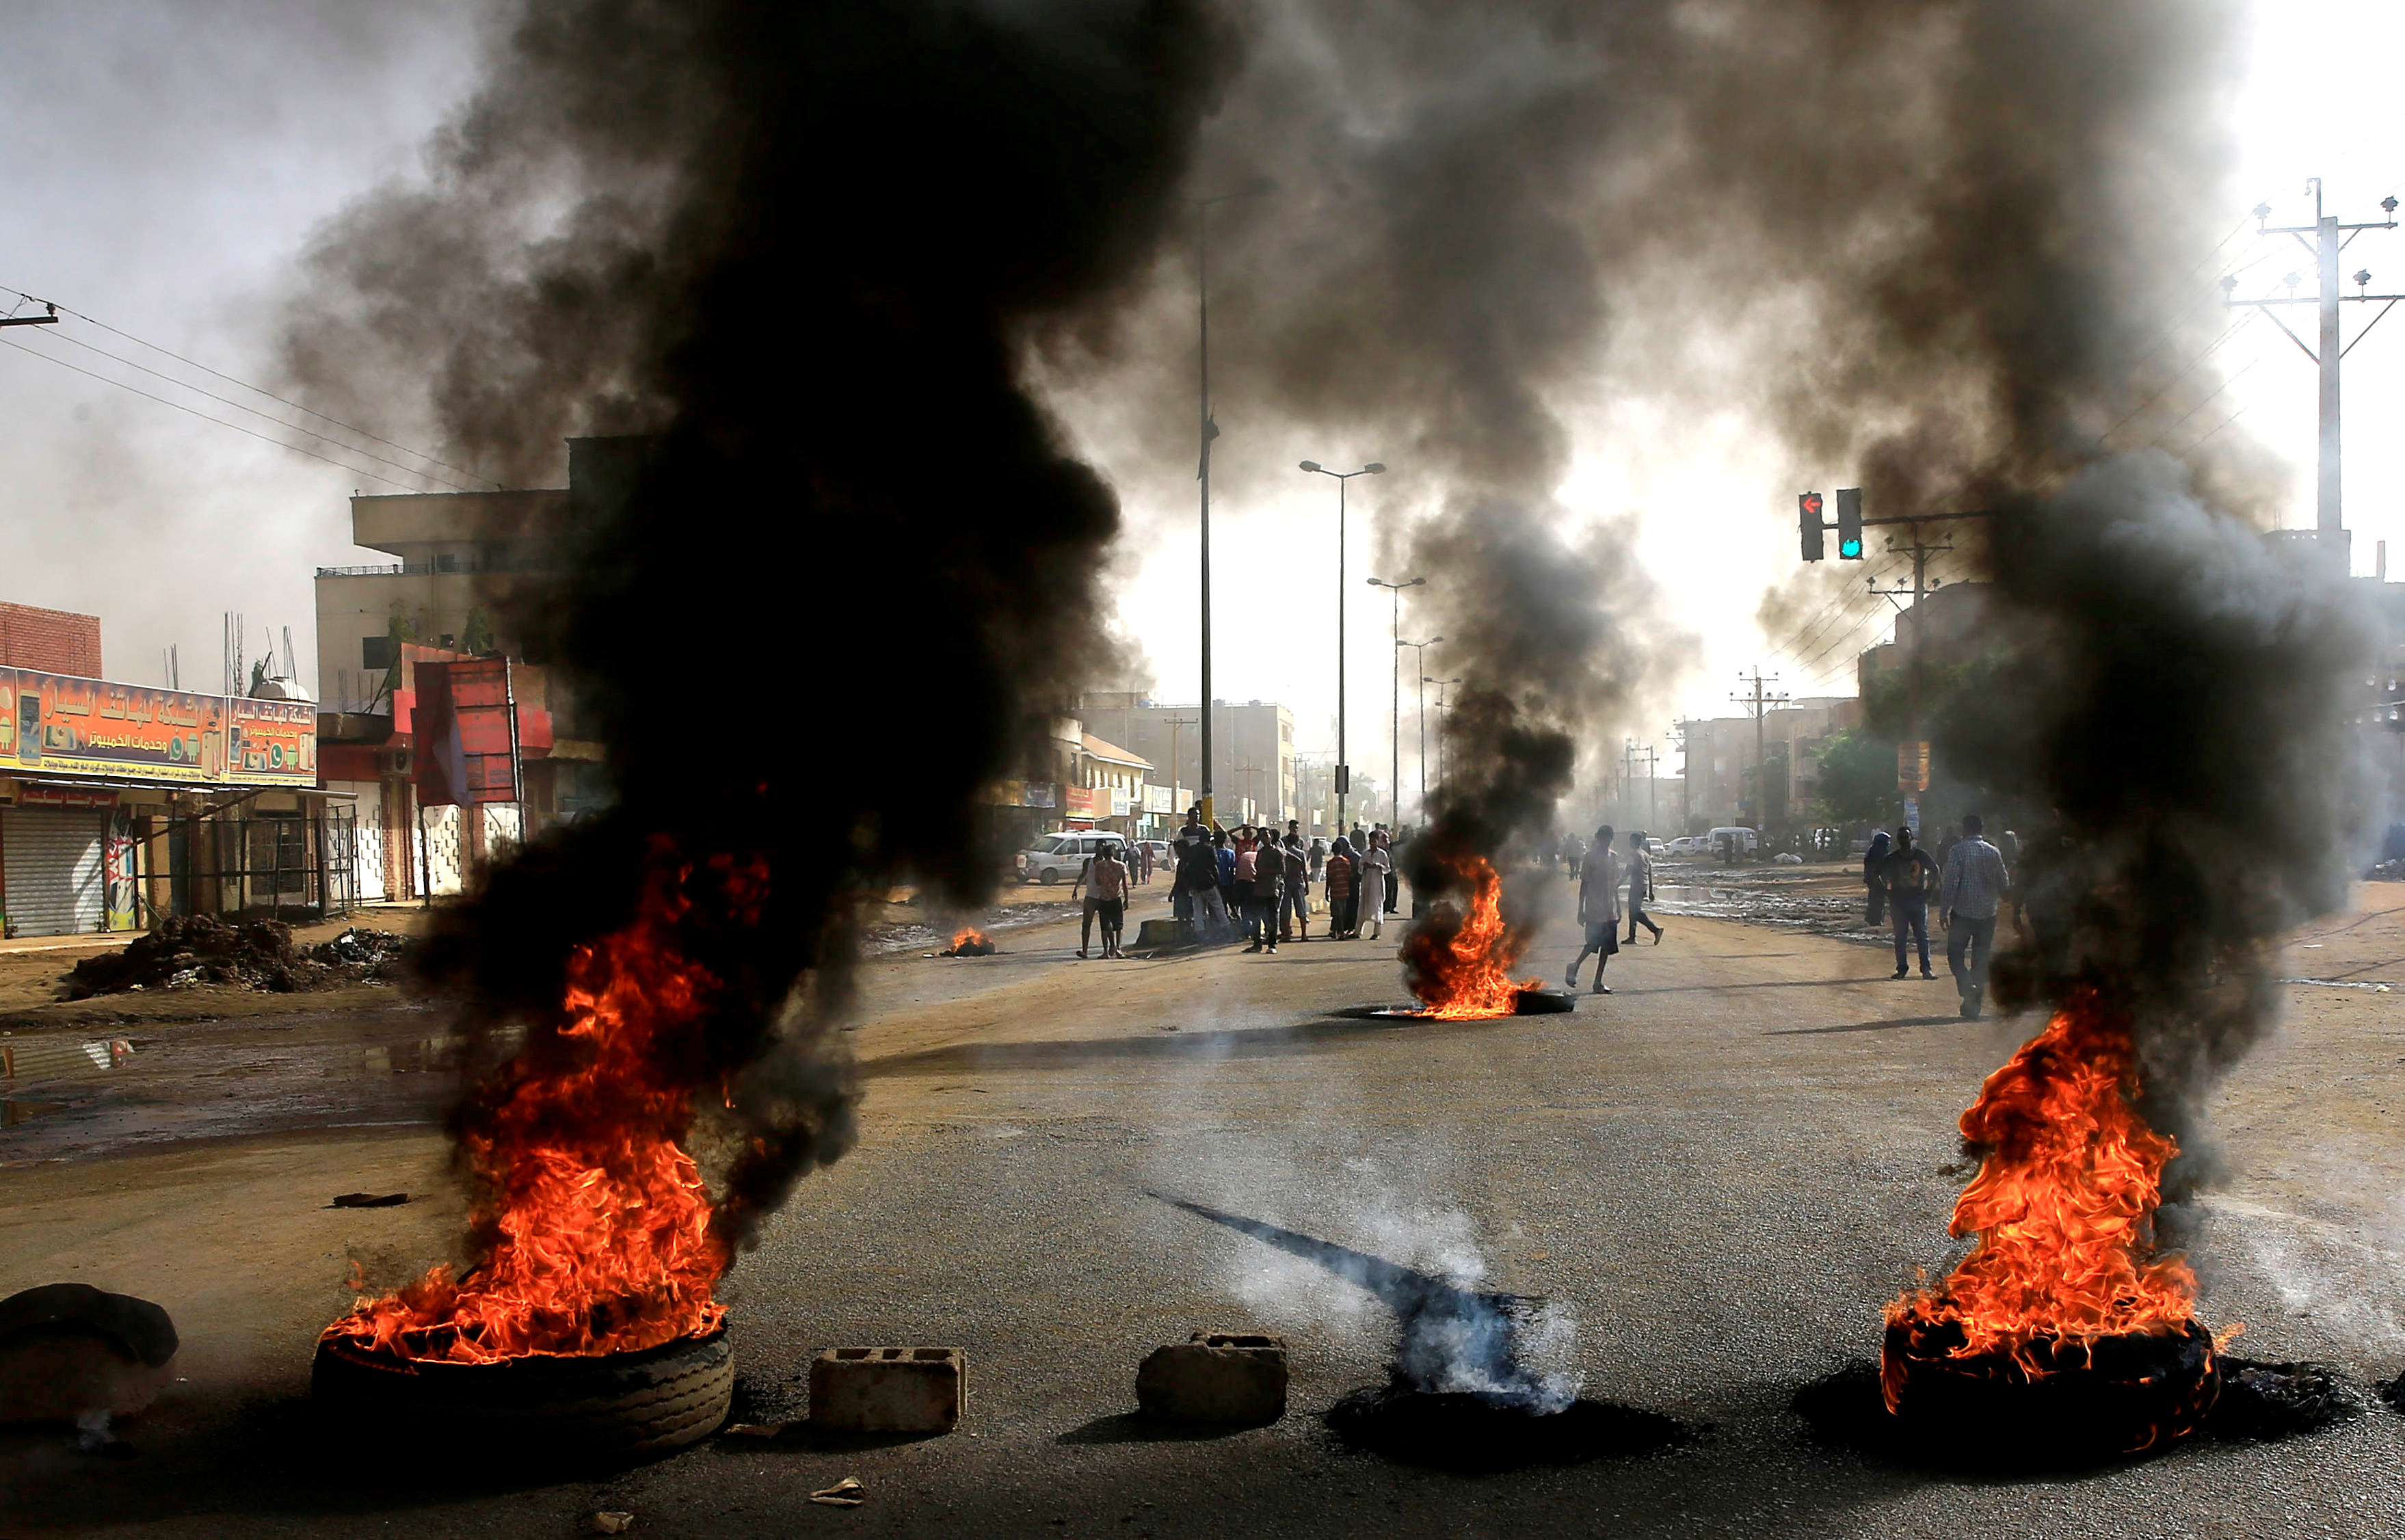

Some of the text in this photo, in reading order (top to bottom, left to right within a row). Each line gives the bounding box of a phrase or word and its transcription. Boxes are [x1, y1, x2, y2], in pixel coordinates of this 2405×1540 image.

[44, 686, 202, 734] الشبكة للهاتف السيار
[260, 705, 287, 726] للهاتف
[289, 706, 314, 728] الشبكة
[88, 731, 167, 754] وخدمات الكمبيوتر
